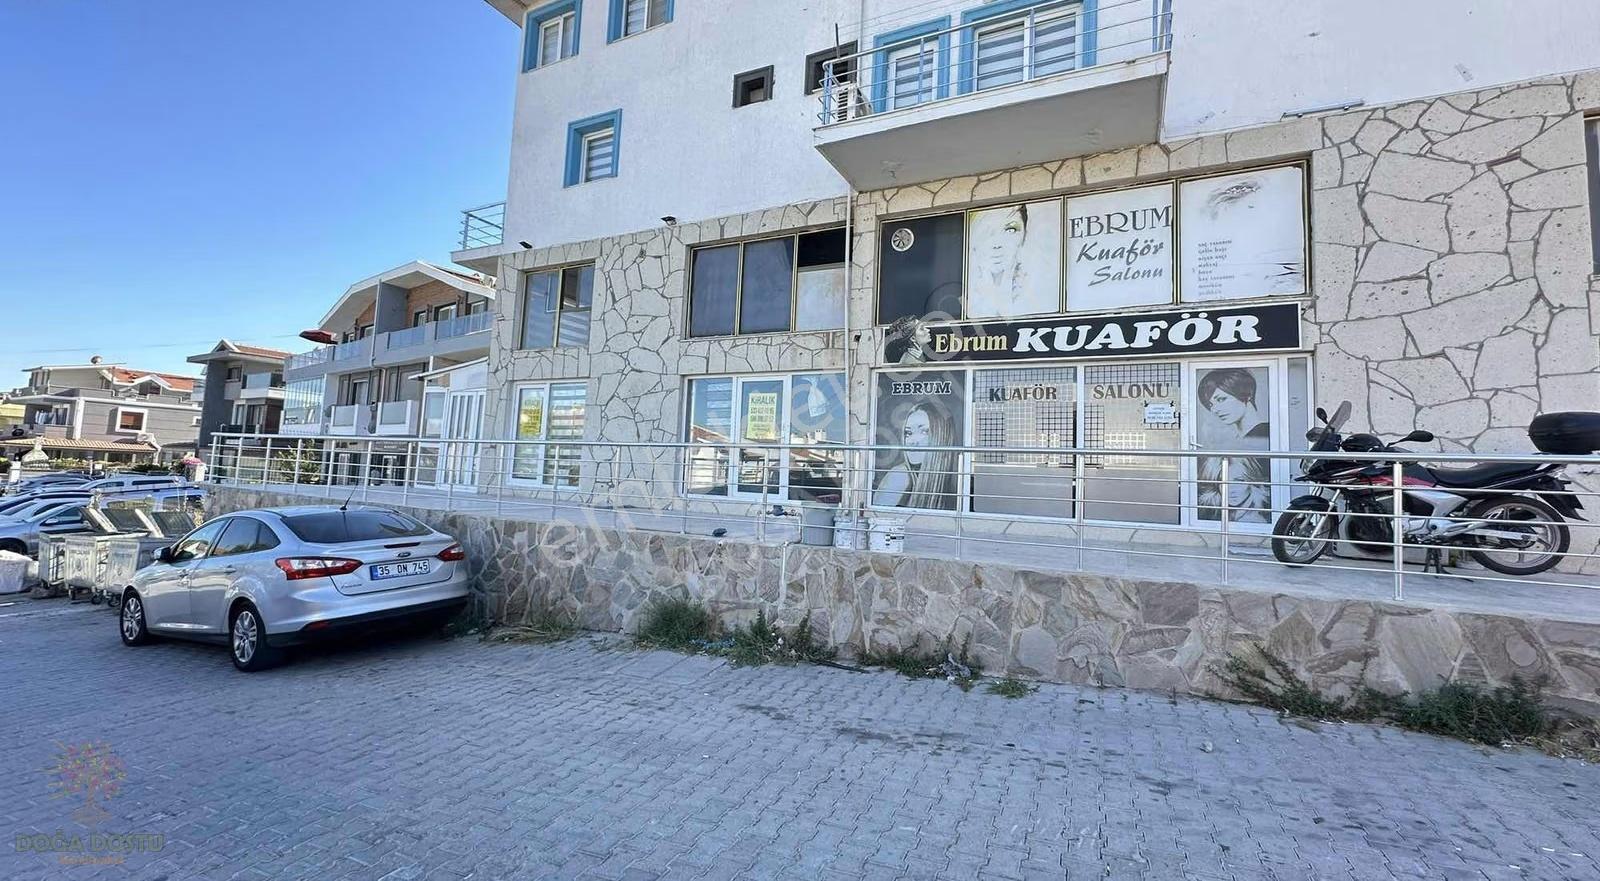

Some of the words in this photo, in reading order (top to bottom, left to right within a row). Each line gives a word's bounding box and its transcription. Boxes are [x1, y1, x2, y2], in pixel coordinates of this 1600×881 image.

[1069, 205, 1172, 239] EBRUM
[1076, 238, 1164, 266] Kuaför
[1088, 265, 1163, 286] Salonu
[934, 332, 1008, 353] Ebrum
[1013, 312, 1262, 352] KUAFÖR
[892, 381, 952, 396] EBRUM
[989, 383, 1057, 401] KUAFÖR
[1093, 382, 1170, 399] SALONU
[378, 565, 390, 576] 35
[412, 561, 428, 572] 745
